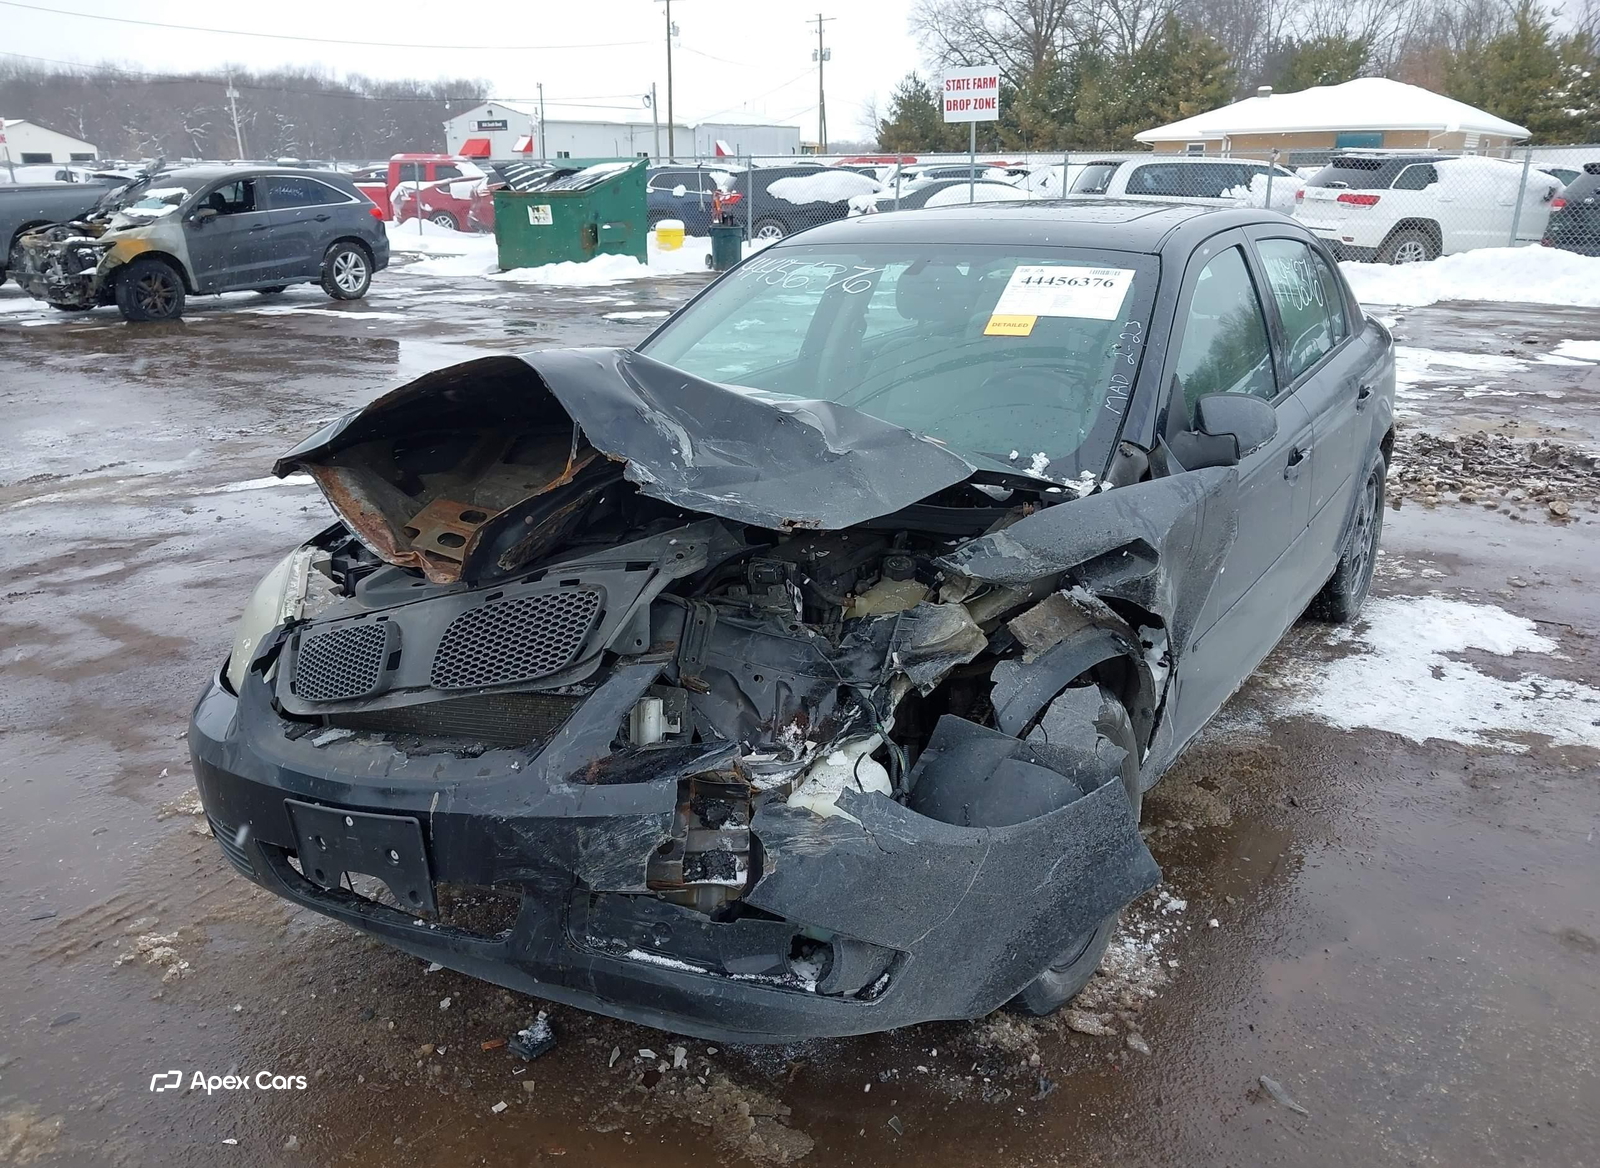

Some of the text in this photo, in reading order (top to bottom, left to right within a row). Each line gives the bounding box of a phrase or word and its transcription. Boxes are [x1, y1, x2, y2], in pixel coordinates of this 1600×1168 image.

[946, 77, 997, 91] STATE FARM
[946, 97, 996, 111] DROP ZONE
[1020, 275, 1115, 288] 44456376
[991, 321, 1029, 329] DETAILED
[1105, 374, 1130, 415] MAD
